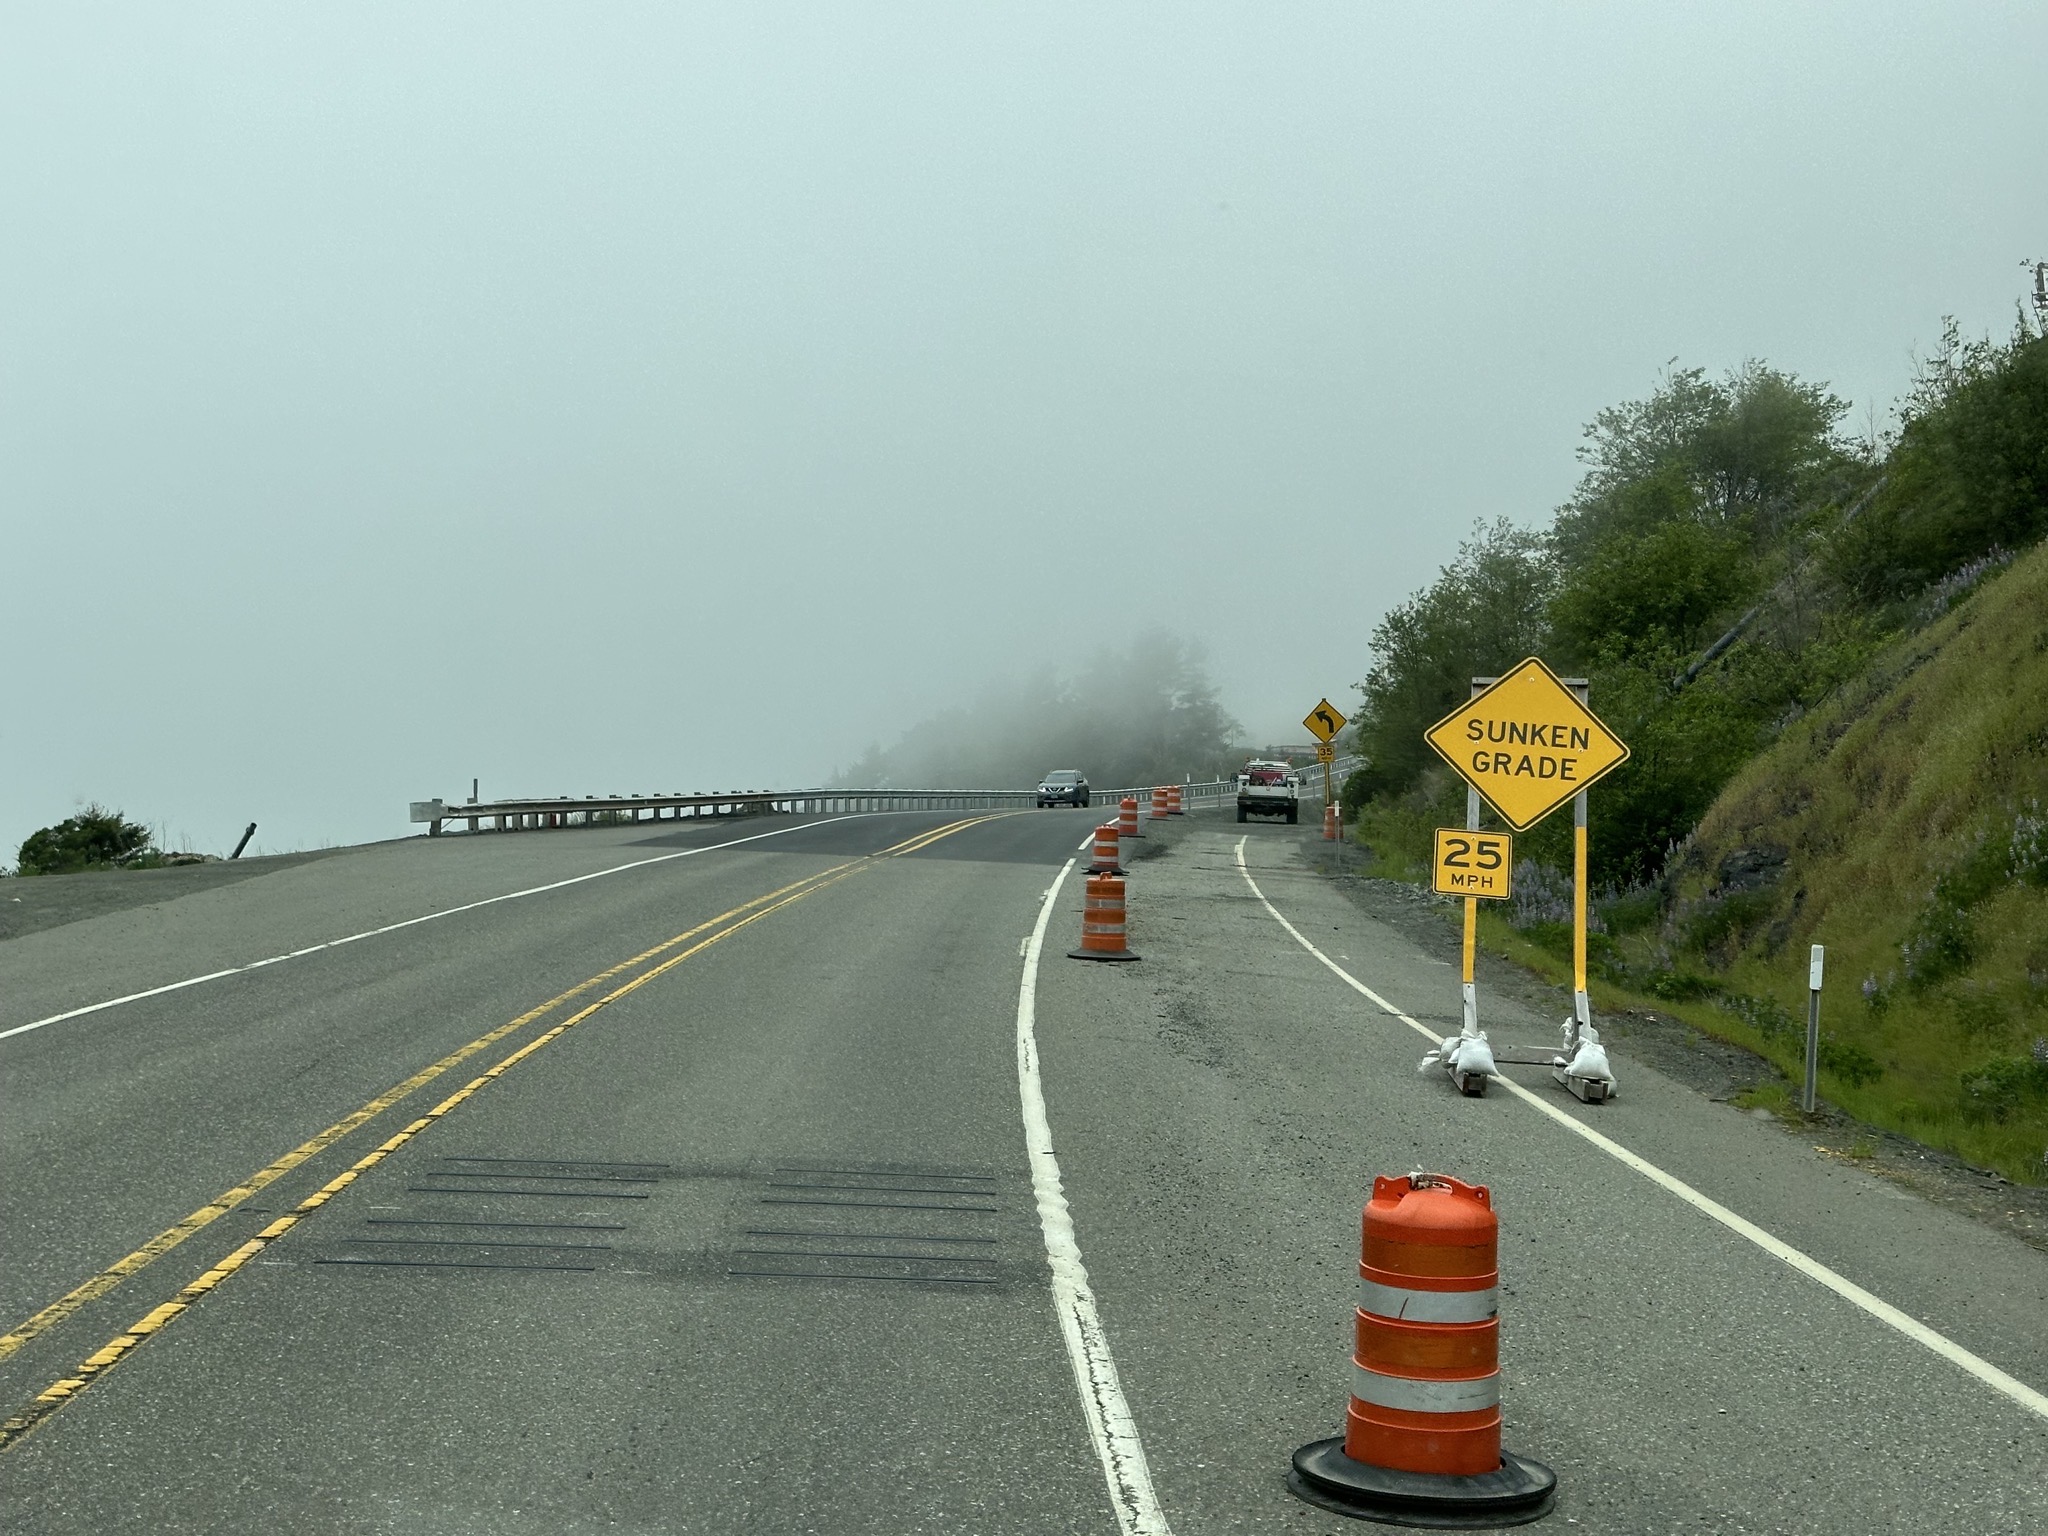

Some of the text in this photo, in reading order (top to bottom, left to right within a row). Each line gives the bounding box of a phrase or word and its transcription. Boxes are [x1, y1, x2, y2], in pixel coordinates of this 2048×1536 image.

[1466, 719, 1589, 750] SUNKEN
[1320, 748, 1333, 756] 35
[1472, 751, 1577, 781] GRADE
[1443, 838, 1502, 870] 25
[1451, 873, 1493, 889] MPH
